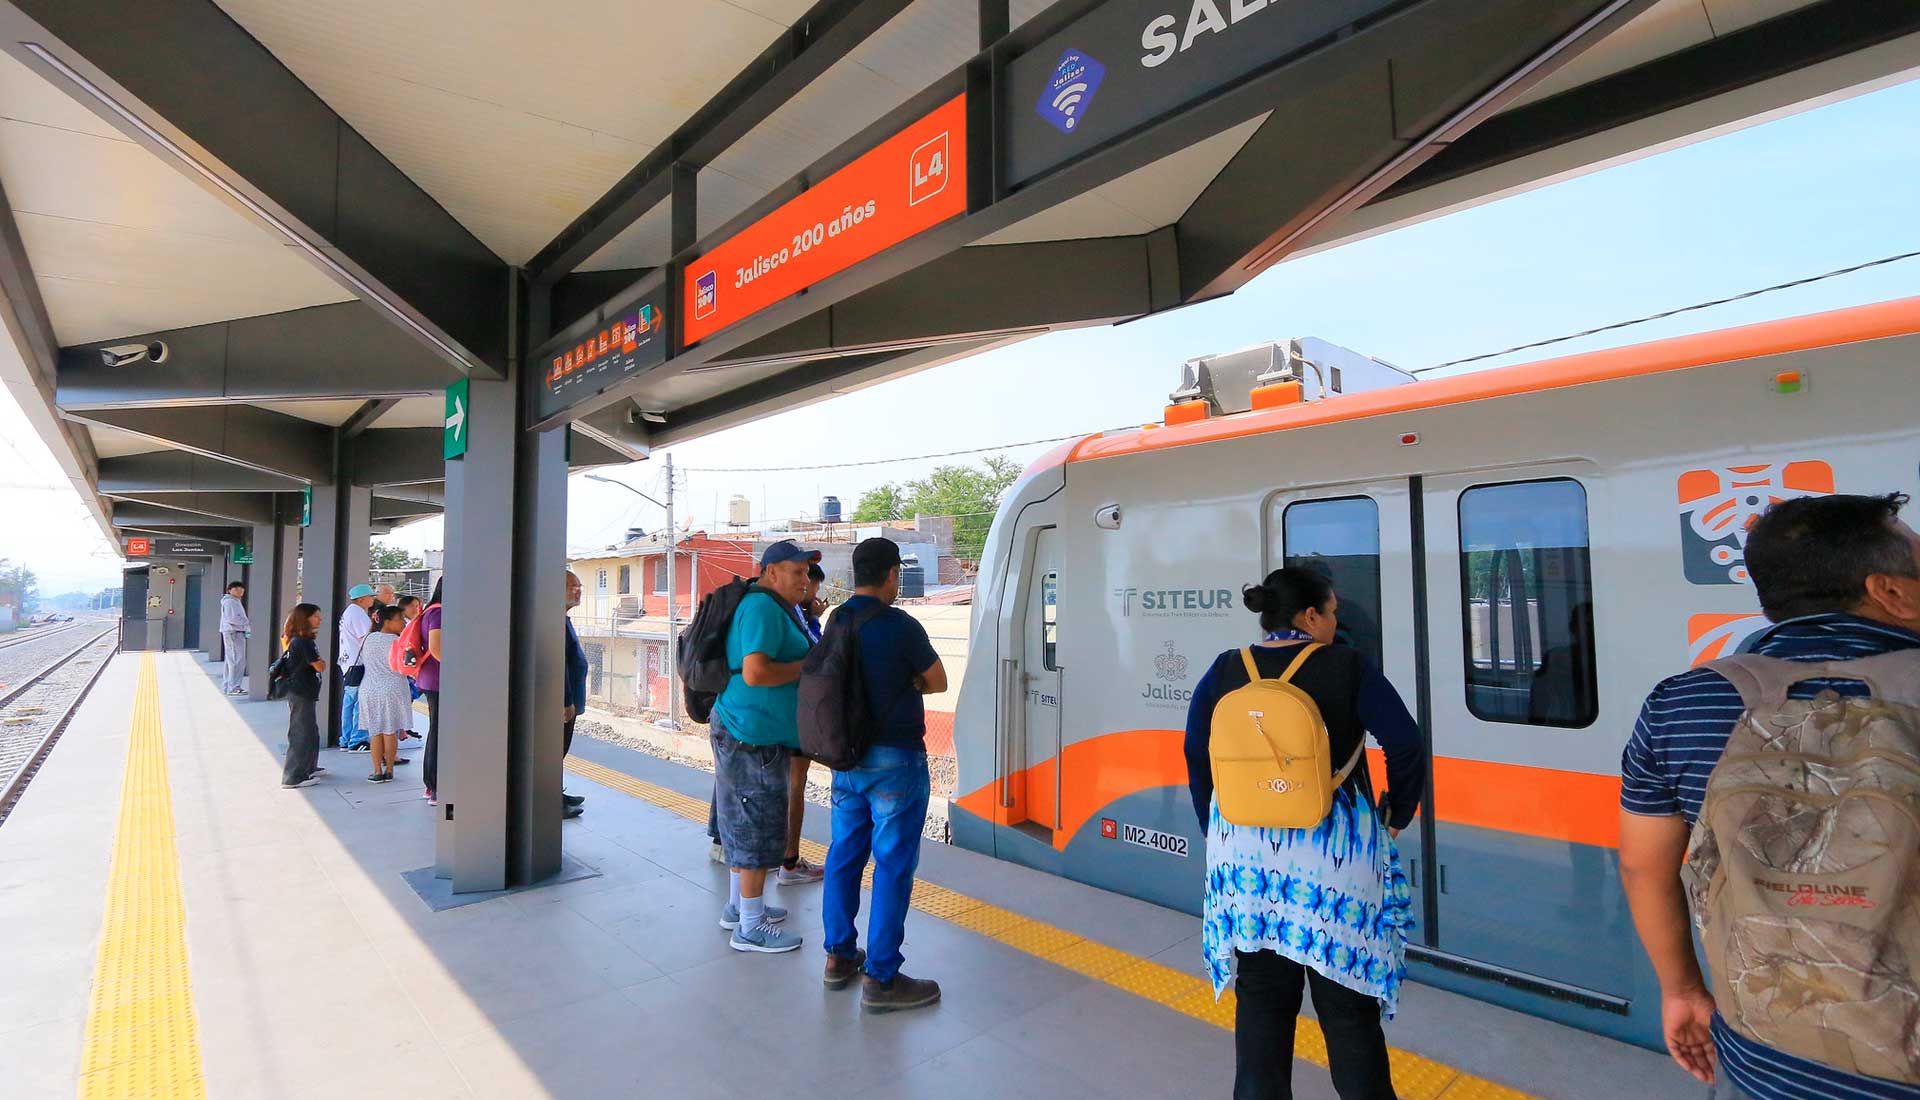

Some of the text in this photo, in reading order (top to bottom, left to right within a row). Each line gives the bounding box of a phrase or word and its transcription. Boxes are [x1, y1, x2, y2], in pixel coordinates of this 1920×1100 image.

[1141, 0, 1279, 68] SAL
[1053, 66, 1085, 87] Jalisco
[914, 151, 943, 187] L4
[735, 199, 876, 289] Jalisco 200 años
[1142, 589, 1233, 610] SITEUR
[1041, 694, 1057, 705] SITE
[1142, 683, 1192, 701] Jalisc
[1125, 825, 1187, 855] M2.4002
